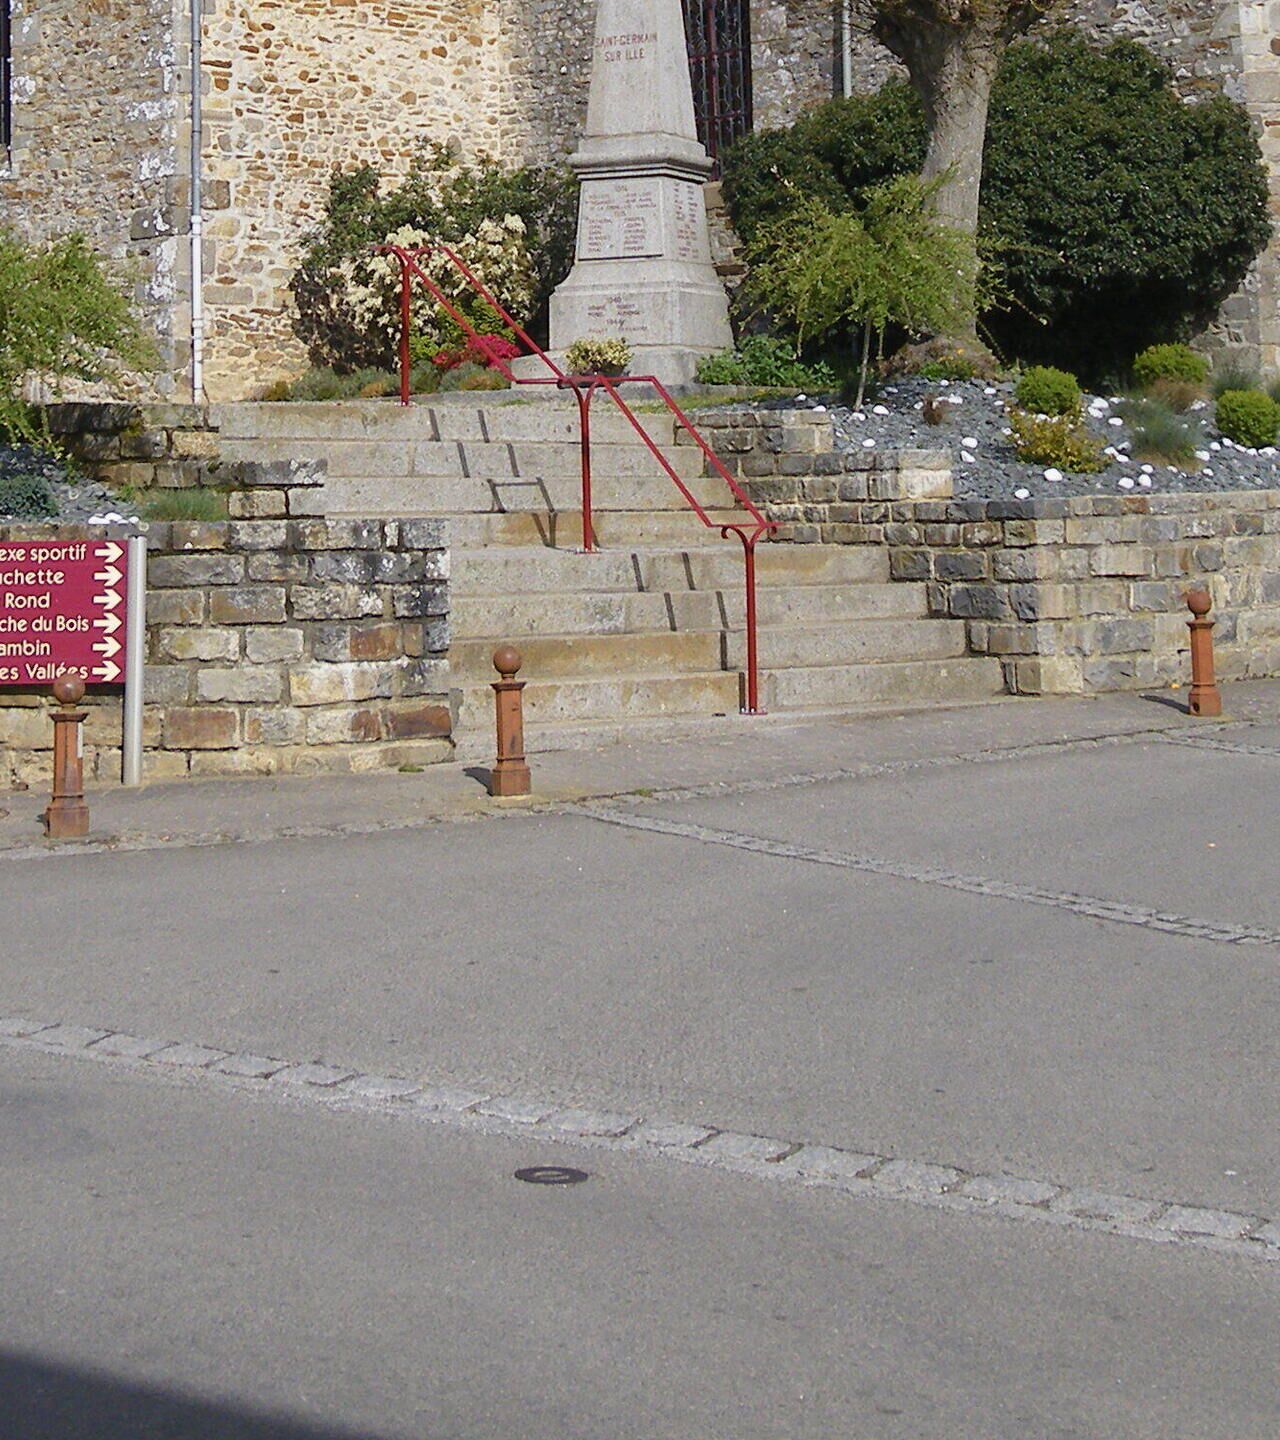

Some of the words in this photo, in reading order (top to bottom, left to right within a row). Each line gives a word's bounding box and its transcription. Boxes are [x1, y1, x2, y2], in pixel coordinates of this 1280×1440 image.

[604, 50, 622, 63] SUR
[30, 544, 87, 564] sportif
[5, 592, 50, 608] Rond
[32, 616, 52, 631] du
[56, 615, 89, 631] Bois
